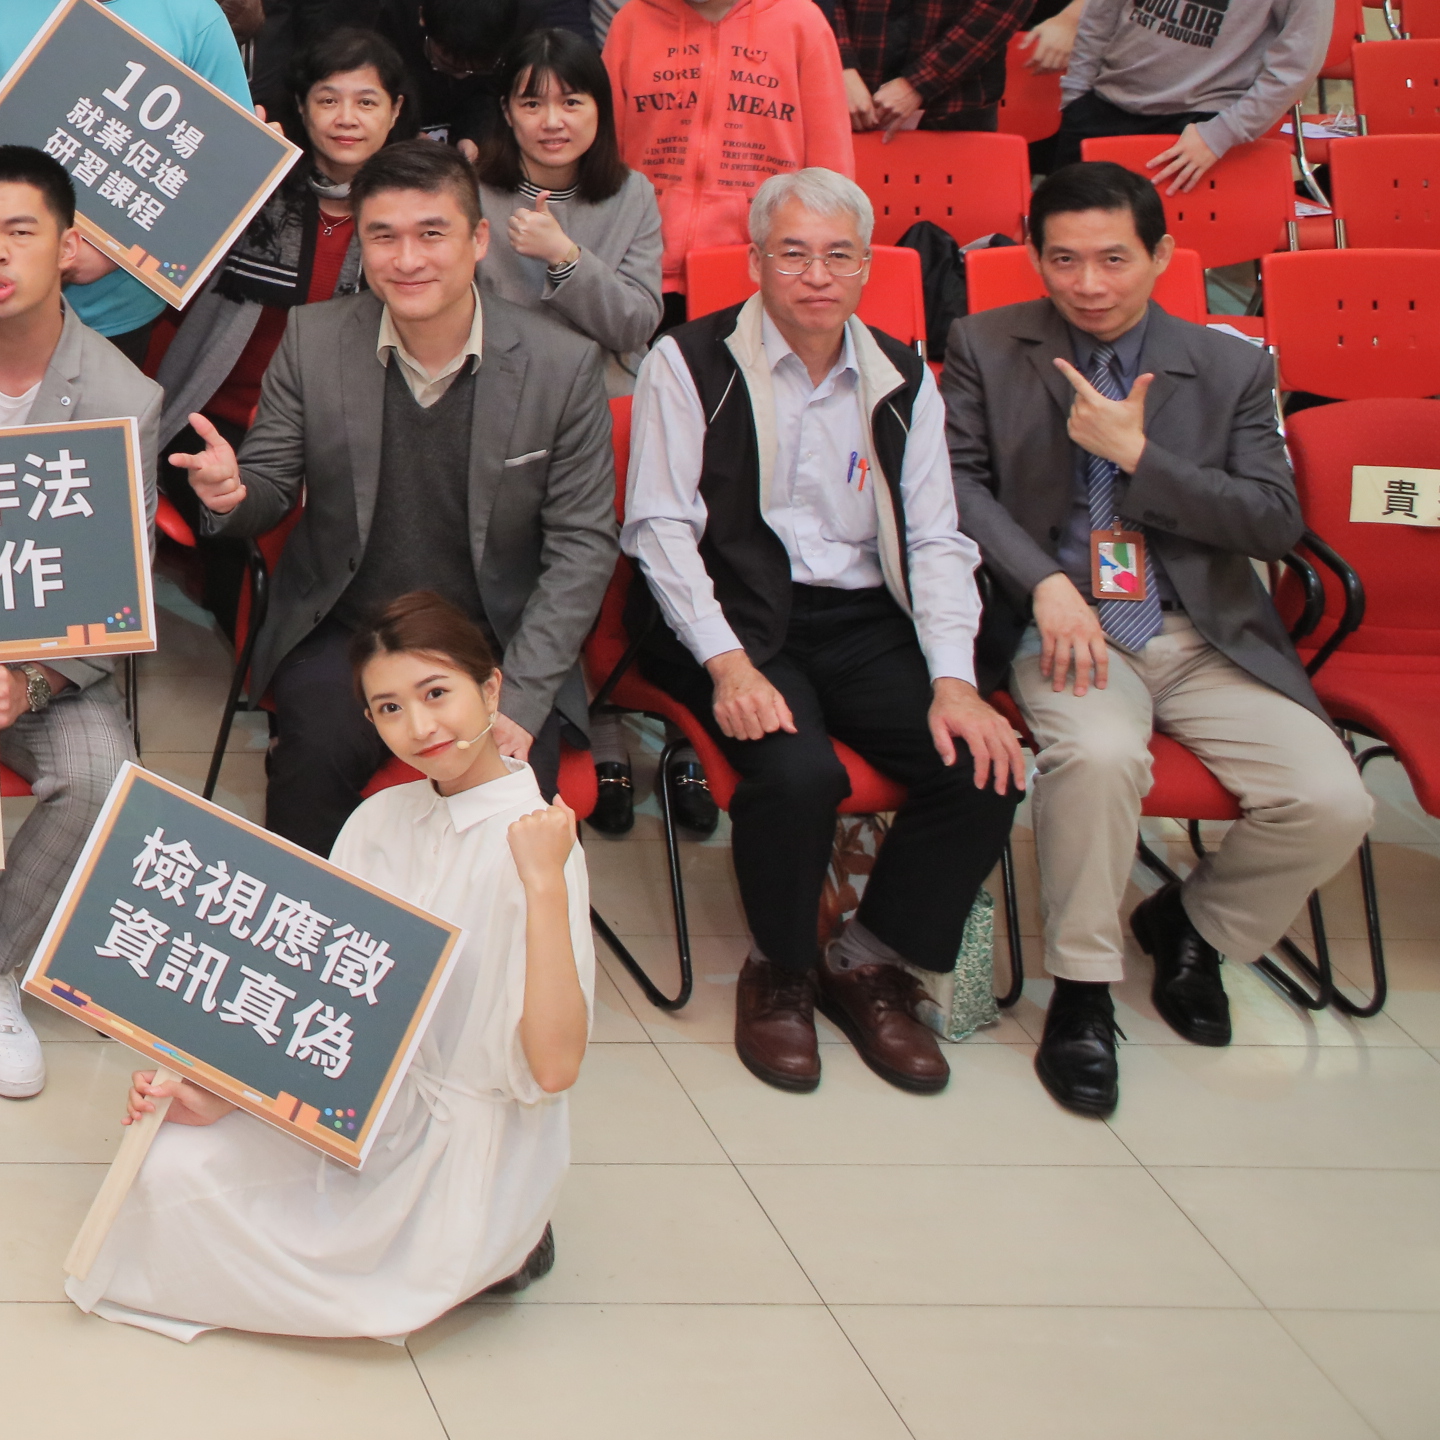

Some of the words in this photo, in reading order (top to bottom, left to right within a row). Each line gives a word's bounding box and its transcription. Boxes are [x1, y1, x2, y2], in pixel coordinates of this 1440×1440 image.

[730, 70, 779, 89] MACD
[1156, 23, 1215, 50] POUVOIR
[65, 96, 190, 202] 就業促進
[101, 60, 207, 160] 10場
[727, 93, 795, 122] MEAR
[42, 127, 168, 233] 研習課程
[131, 826, 395, 1007] 檢視應徵
[93, 898, 357, 1080] 資訊真偽
